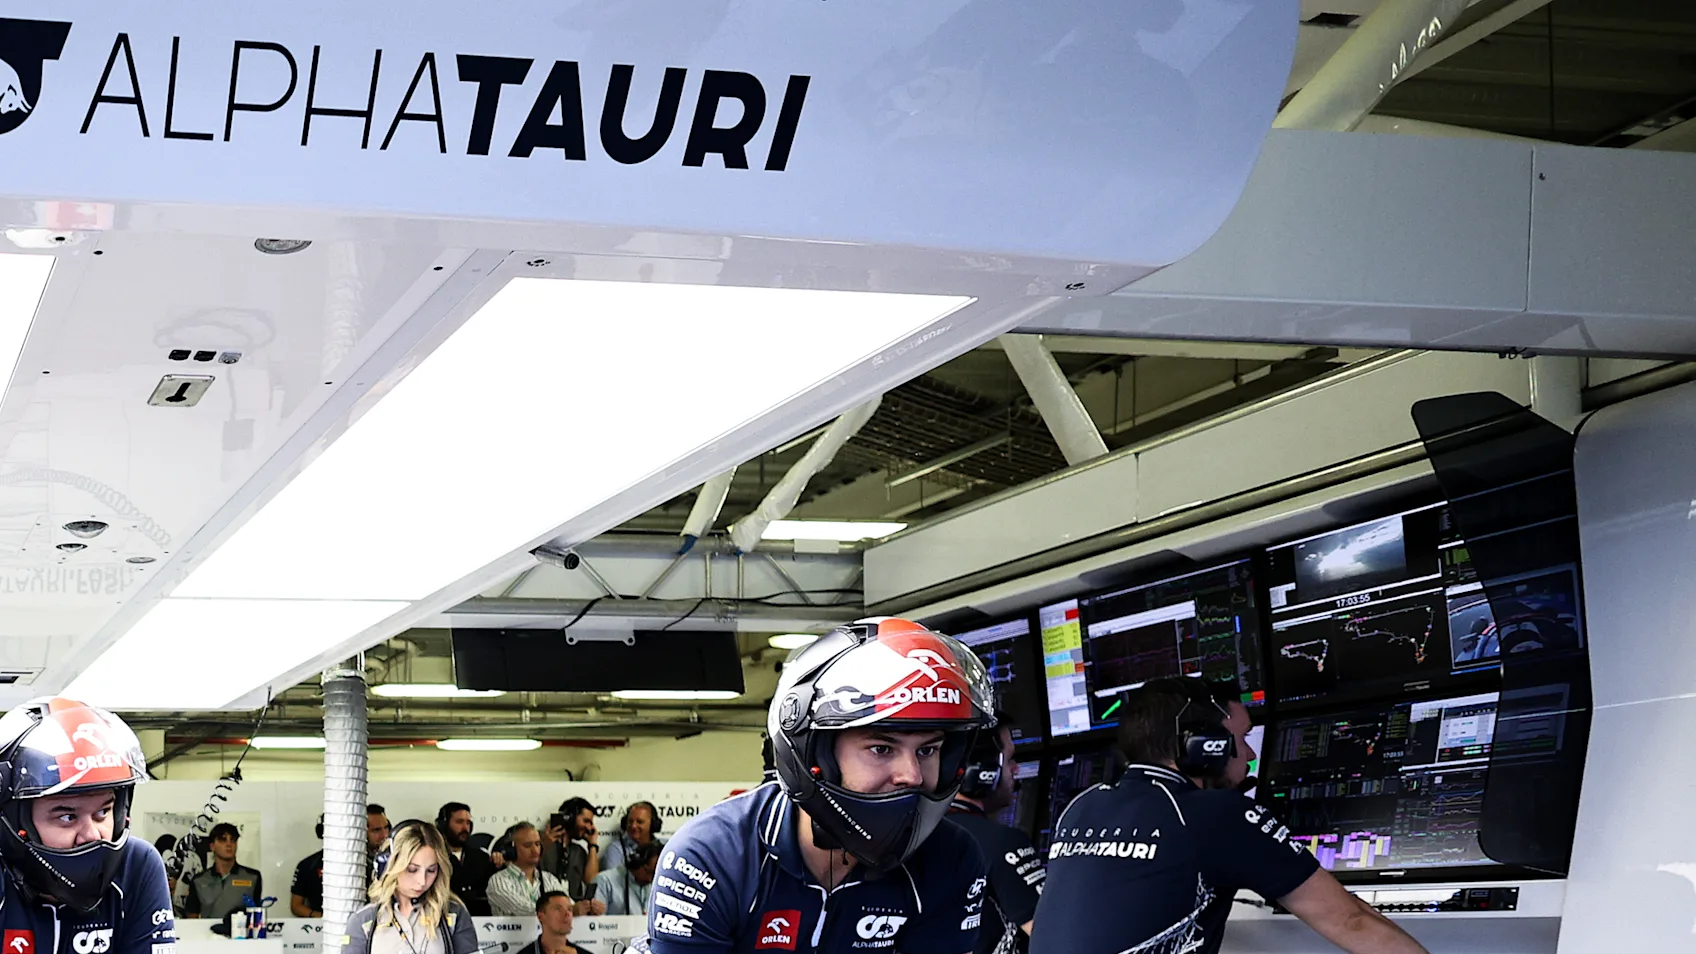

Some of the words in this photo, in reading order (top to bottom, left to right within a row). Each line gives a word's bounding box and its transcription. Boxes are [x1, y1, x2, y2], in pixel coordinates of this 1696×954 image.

[79, 31, 811, 172] ALPHATAURI
[1335, 593, 1371, 608] 17:03:55
[896, 686, 961, 705] ORLEN
[73, 755, 123, 771] ORLEN
[618, 805, 700, 817] ATAURI
[1059, 843, 1158, 860] ALPHATAURI
[674, 857, 717, 890] Rapid
[654, 911, 694, 933] HRC
[761, 935, 791, 945] ORLEN
